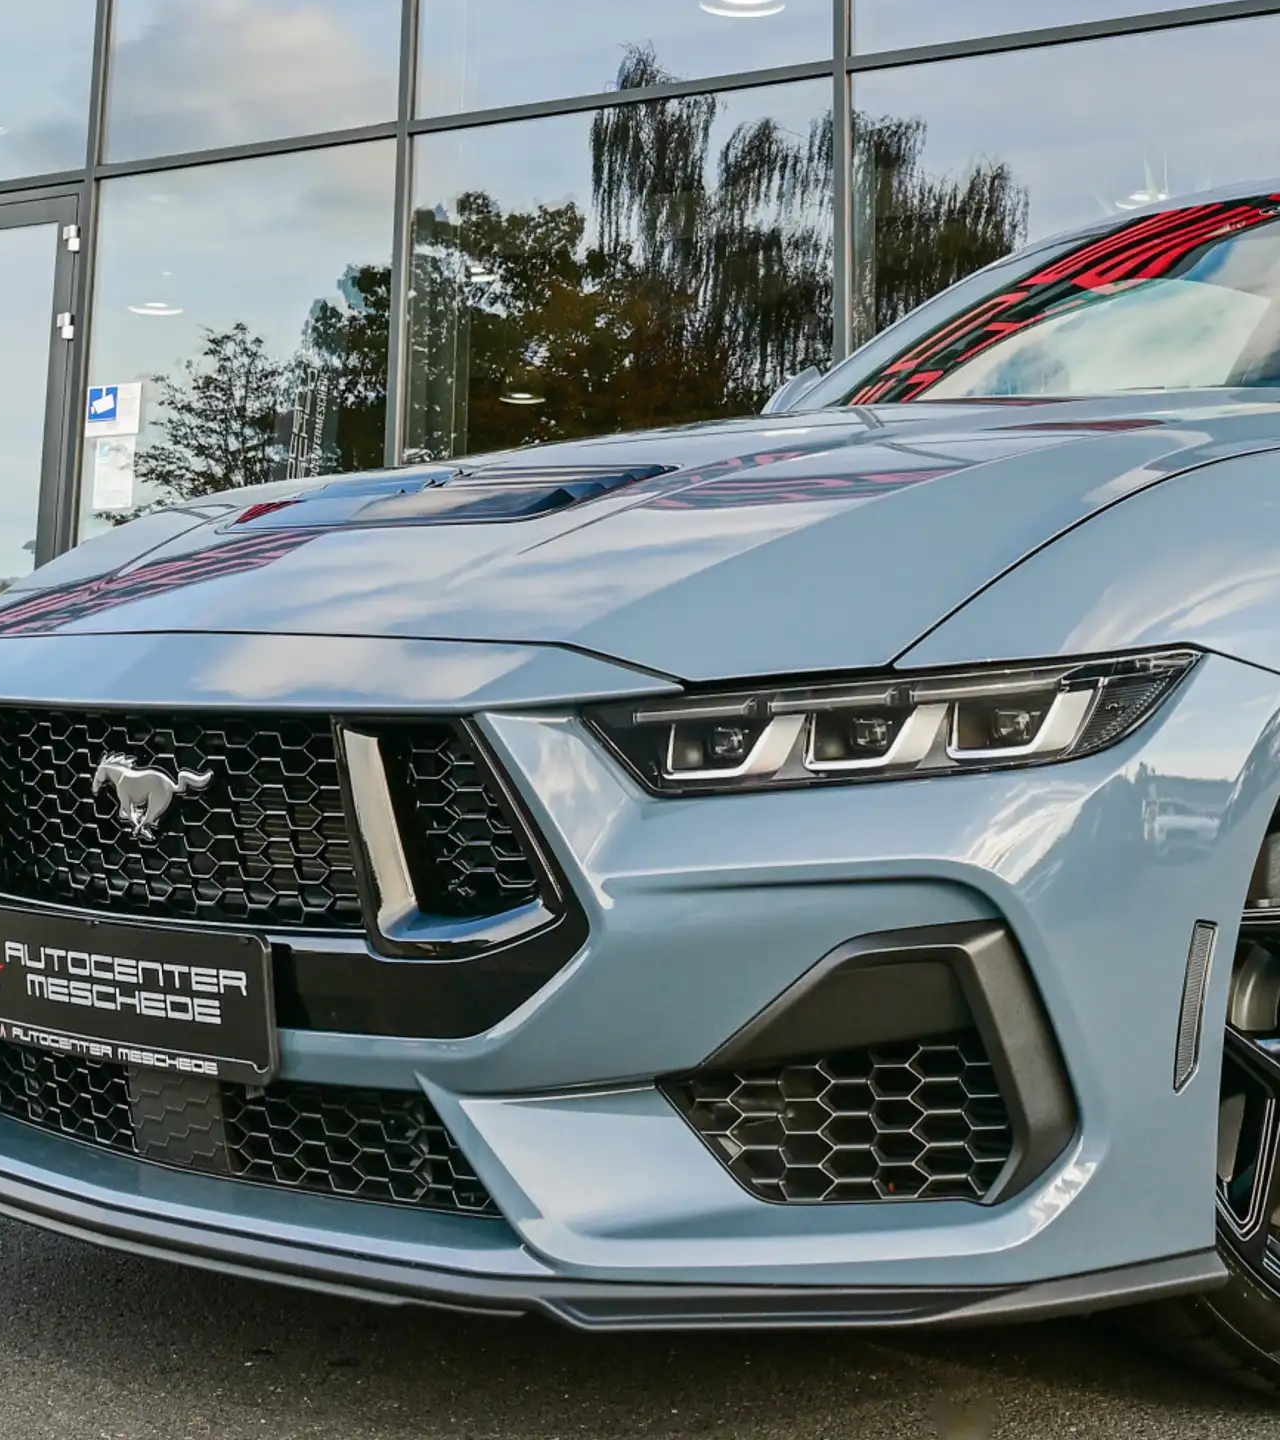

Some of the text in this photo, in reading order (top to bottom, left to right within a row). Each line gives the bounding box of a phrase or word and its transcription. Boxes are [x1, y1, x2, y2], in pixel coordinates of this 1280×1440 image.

[4, 940, 248, 997] AUTOCENTER
[26, 973, 222, 1025] MESCHEDE
[11, 1026, 113, 1059] AUTOCENTER
[117, 1047, 219, 1076] MESCHEDE
